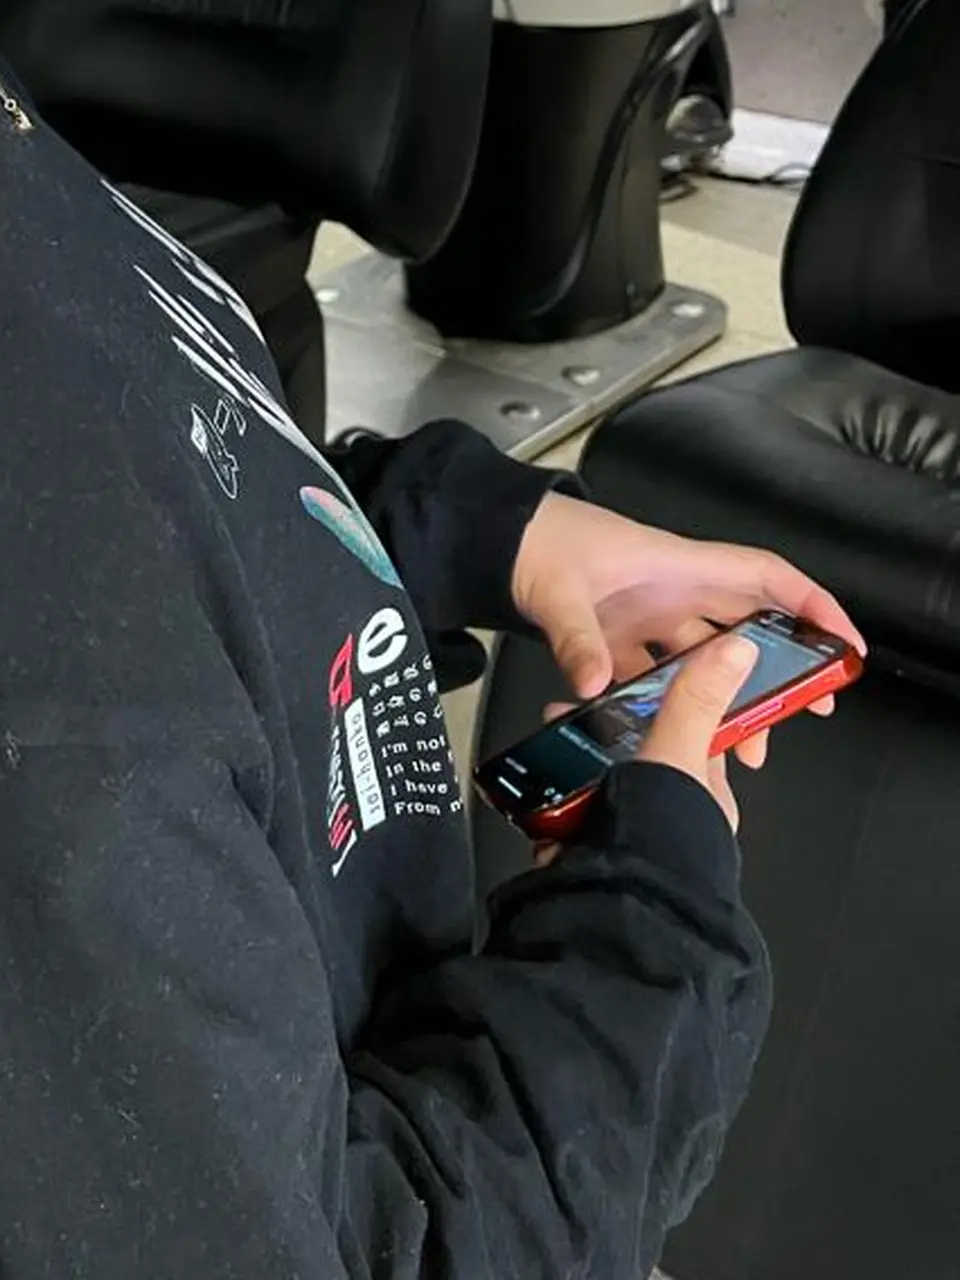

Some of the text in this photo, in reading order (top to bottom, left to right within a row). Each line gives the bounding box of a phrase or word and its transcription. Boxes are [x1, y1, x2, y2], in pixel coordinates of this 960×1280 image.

[381, 742, 408, 758] I'm
[412, 759, 442, 772] the
[405, 779, 448, 794] have
[394, 801, 441, 816] From
